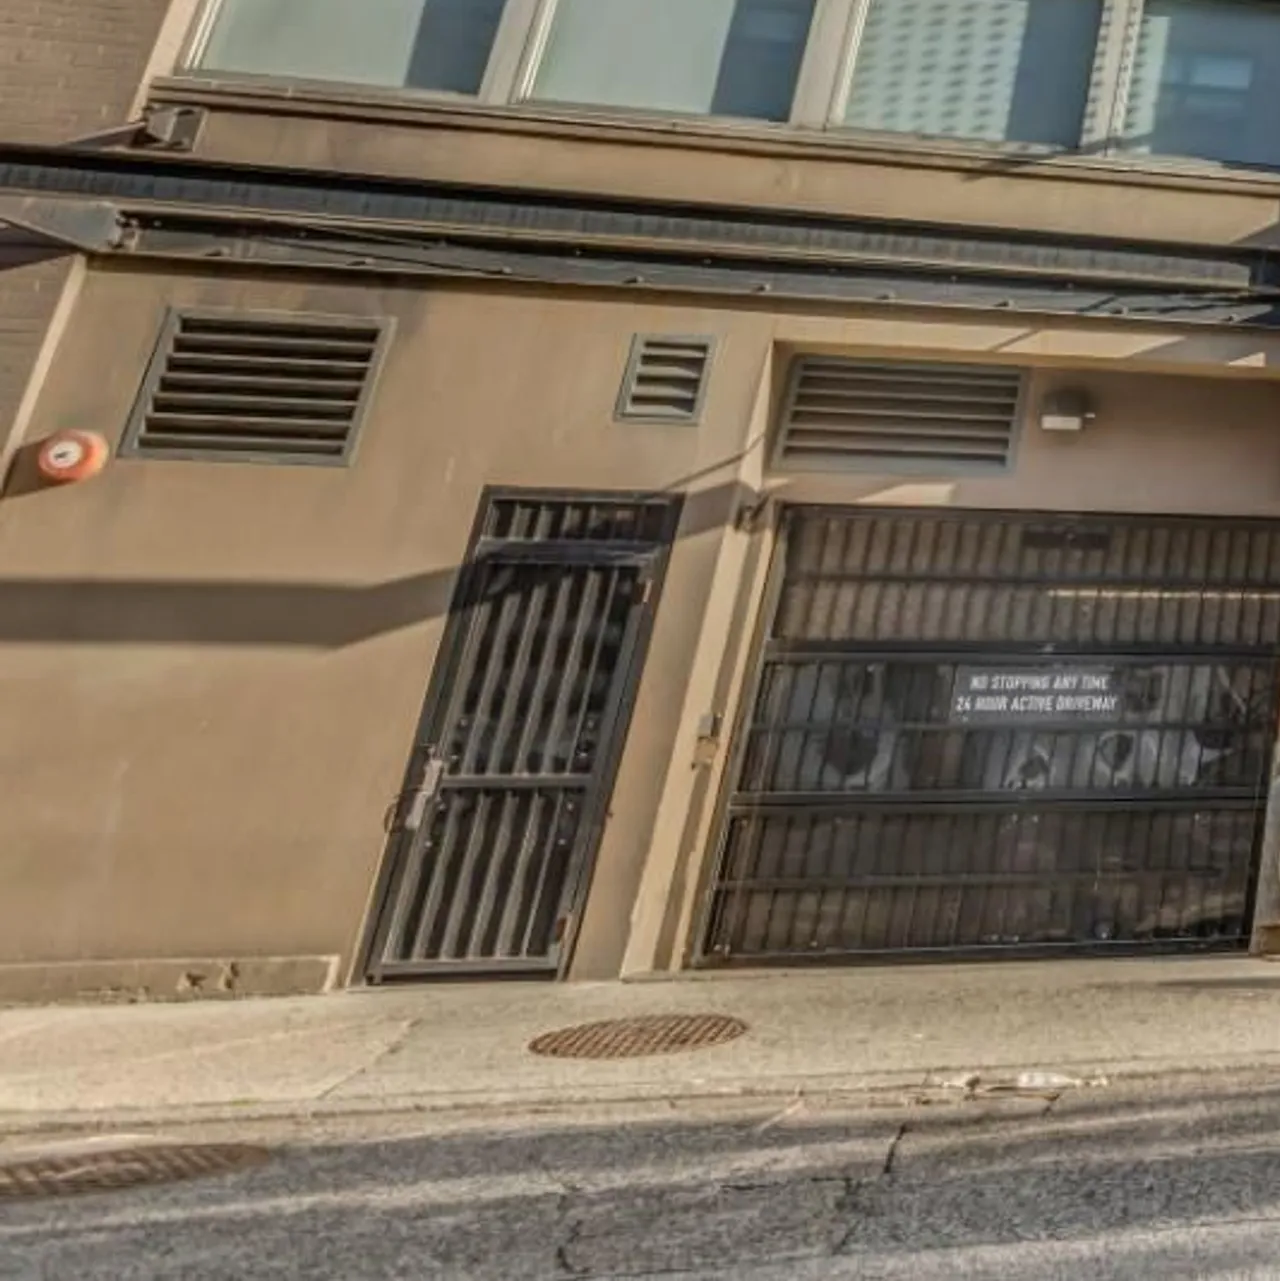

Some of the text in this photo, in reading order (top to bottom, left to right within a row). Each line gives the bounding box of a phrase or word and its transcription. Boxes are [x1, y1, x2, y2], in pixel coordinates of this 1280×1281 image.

[969, 675, 1110, 690] NO STOPPING ANY TIME
[956, 695, 1118, 711] 24 HOUR ACTIVE DRIVEWAY
